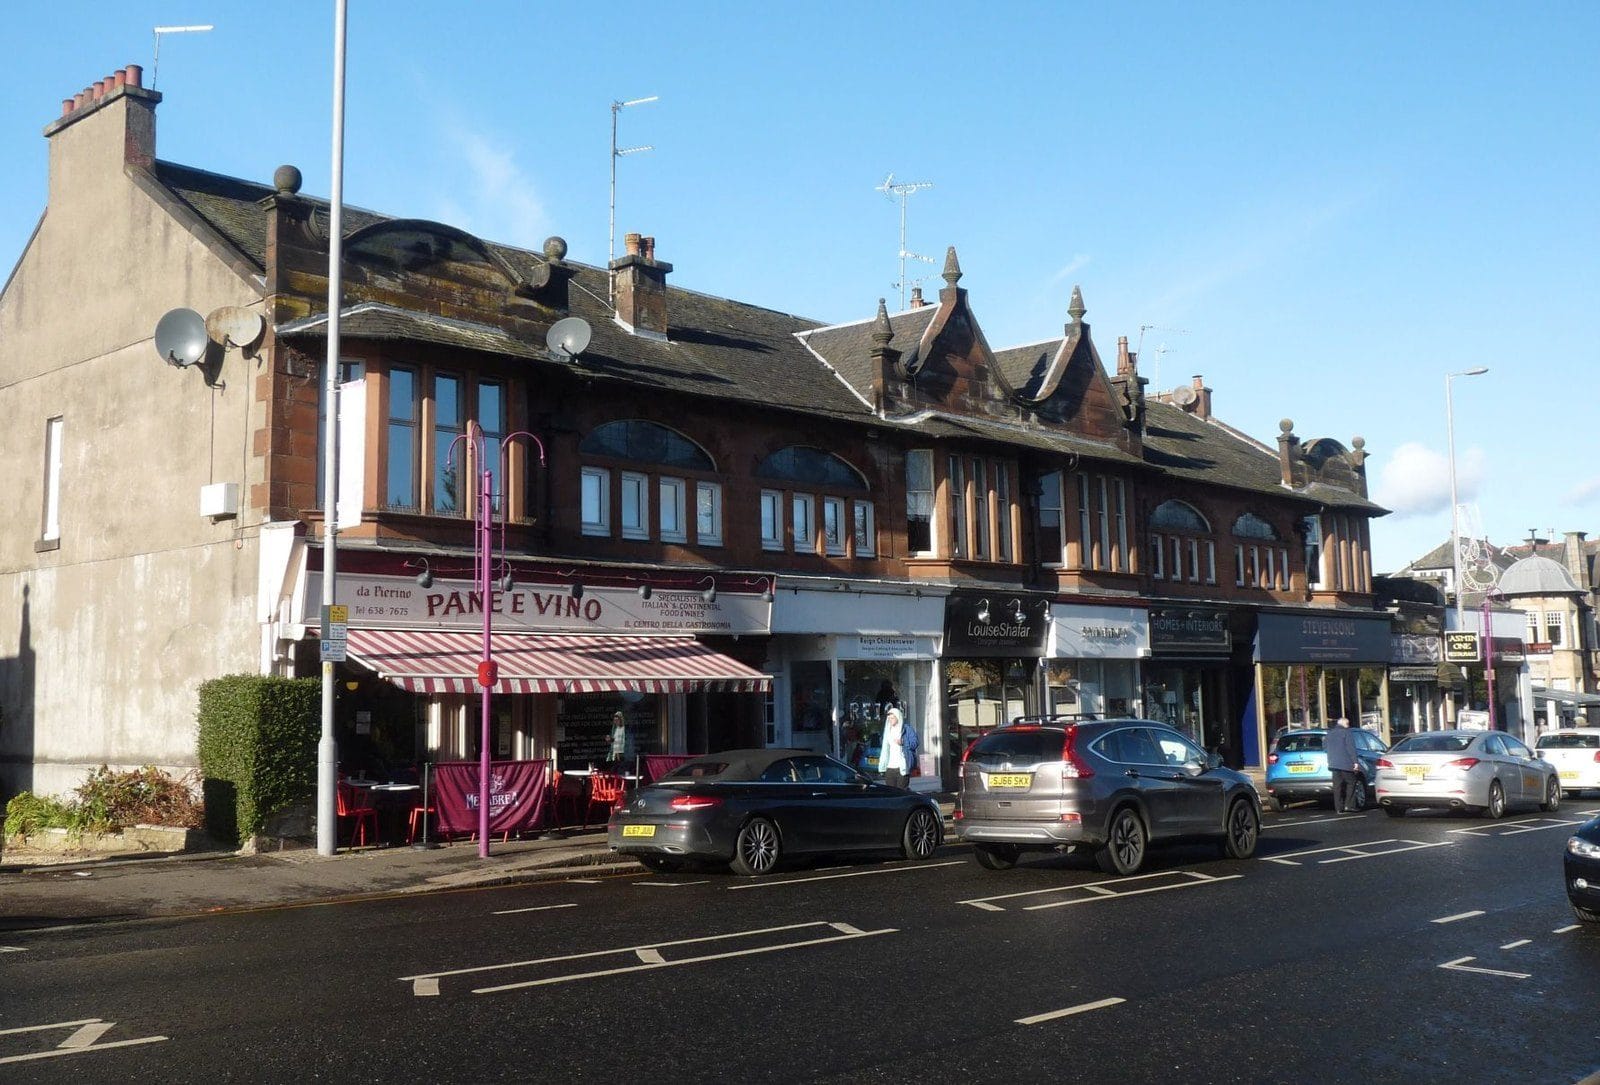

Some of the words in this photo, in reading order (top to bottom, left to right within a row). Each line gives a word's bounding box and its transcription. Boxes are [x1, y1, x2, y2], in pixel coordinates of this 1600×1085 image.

[356, 586, 370, 597] da
[374, 586, 412, 598] Pierino
[658, 593, 698, 603] SPECIALISTS
[355, 605, 365, 615] Tel
[426, 590, 503, 617] PANE
[511, 593, 525, 614] E
[532, 592, 602, 621] VINO
[641, 601, 669, 609] ITALIAN
[679, 603, 721, 611] CONTINENTAL
[633, 621, 660, 629] CENTRO
[662, 621, 683, 629] DELLA
[685, 621, 732, 629] GASTRONOMIA
[993, 776, 1012, 785] SJ66
[1014, 776, 1029, 785] SKX
[466, 791, 519, 809] MEBREA
